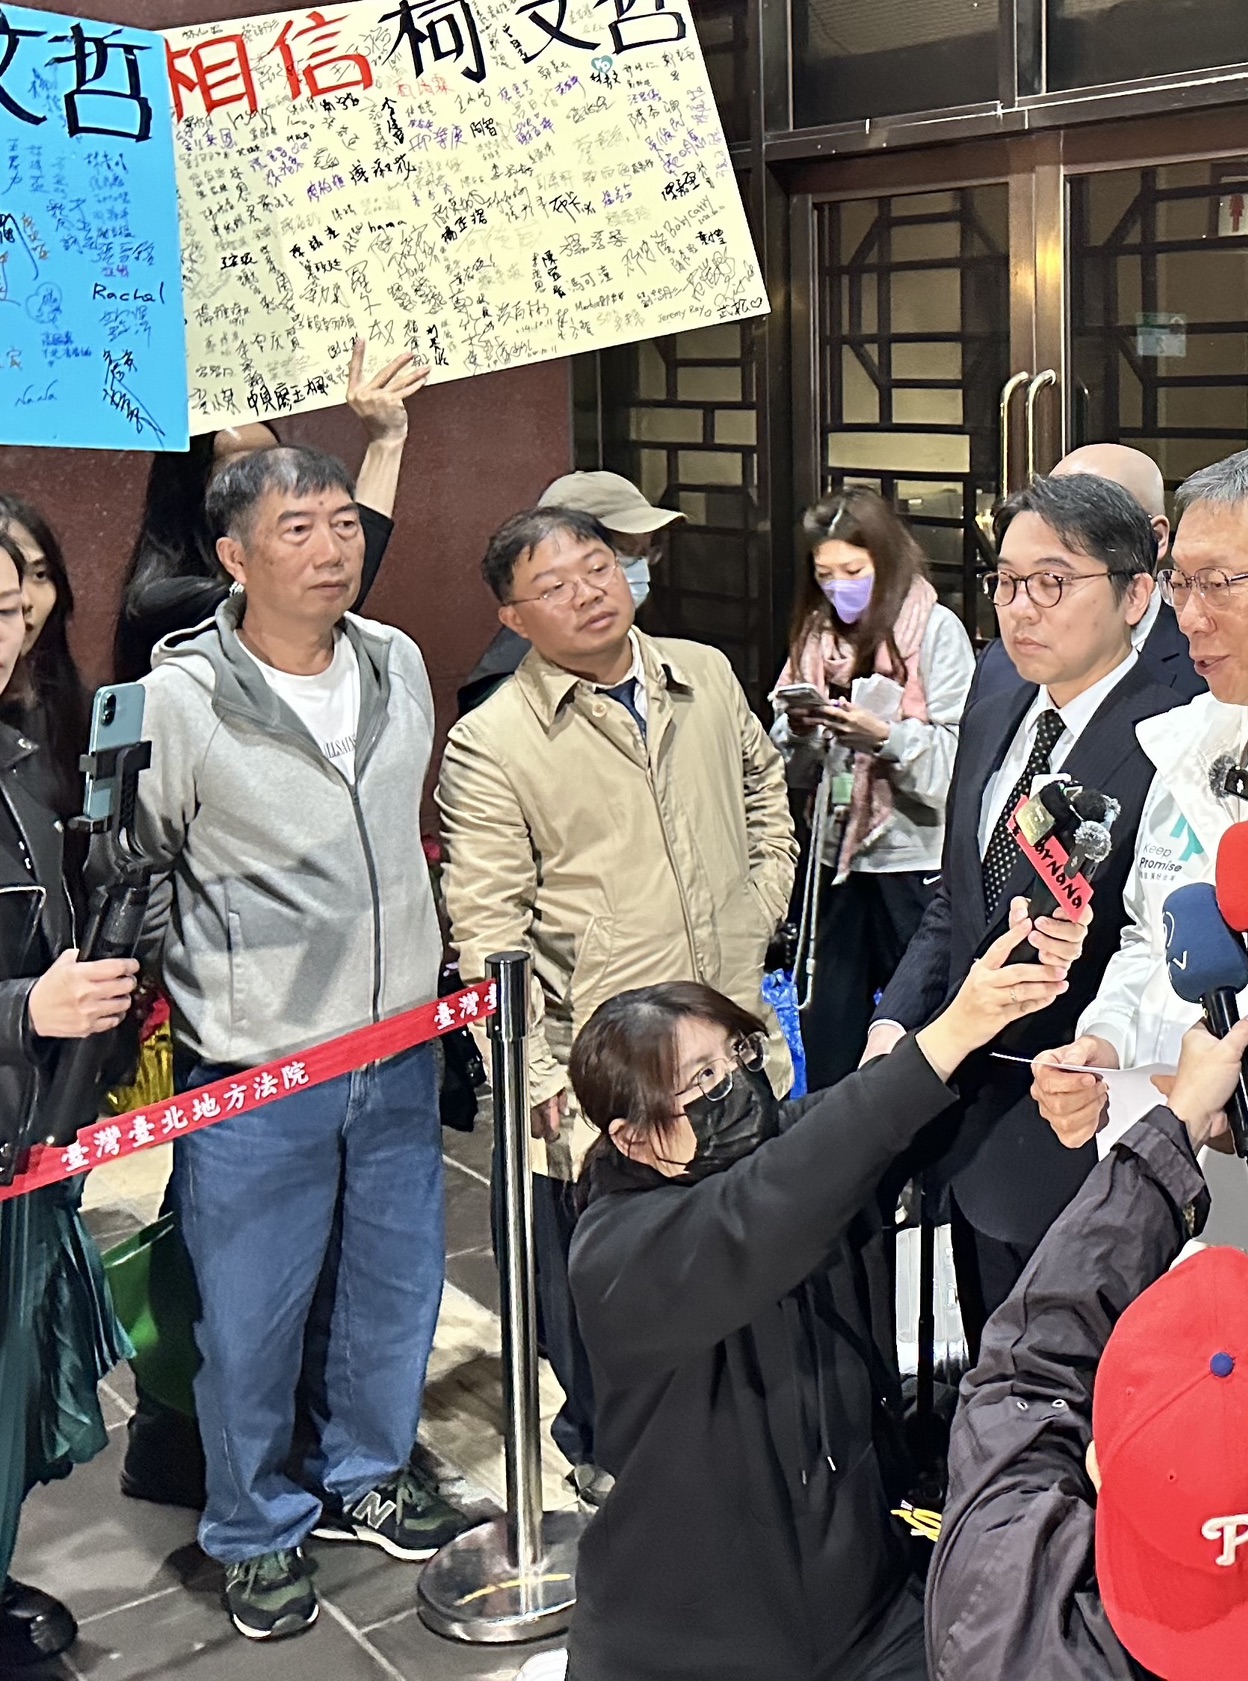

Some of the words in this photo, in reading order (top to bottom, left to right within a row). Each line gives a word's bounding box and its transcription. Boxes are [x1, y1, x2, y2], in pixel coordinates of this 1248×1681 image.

[1143, 842, 1172, 859] Keep
[1140, 857, 1182, 872] Promise
[61, 1060, 310, 1172] 臺灣臺北地方法院
